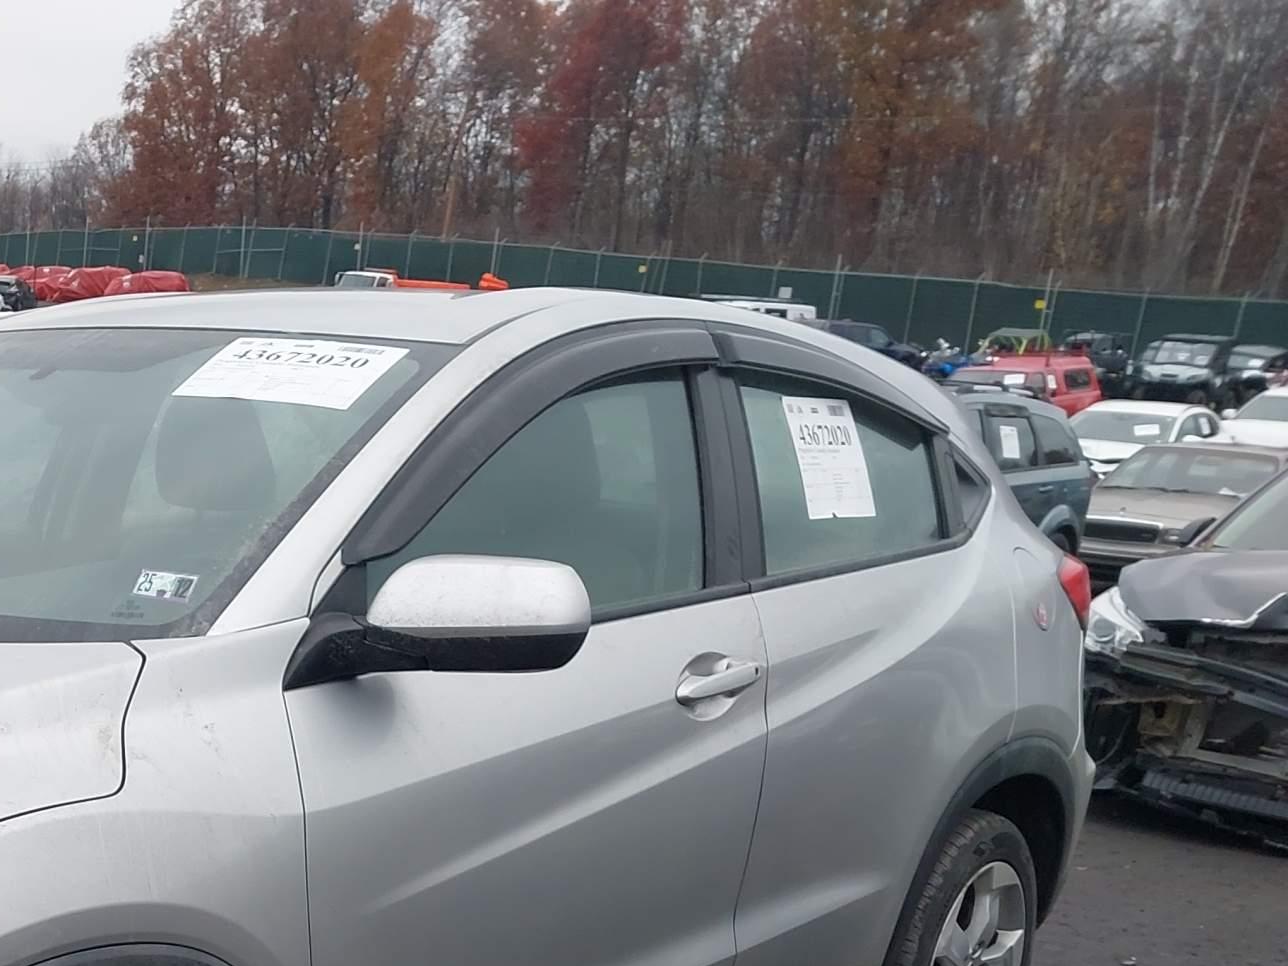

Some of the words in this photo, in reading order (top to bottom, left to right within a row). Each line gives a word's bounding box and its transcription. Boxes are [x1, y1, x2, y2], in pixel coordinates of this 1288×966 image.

[233, 348, 370, 369] 43672020
[799, 423, 852, 446] 43672020
[136, 572, 158, 593] 25
